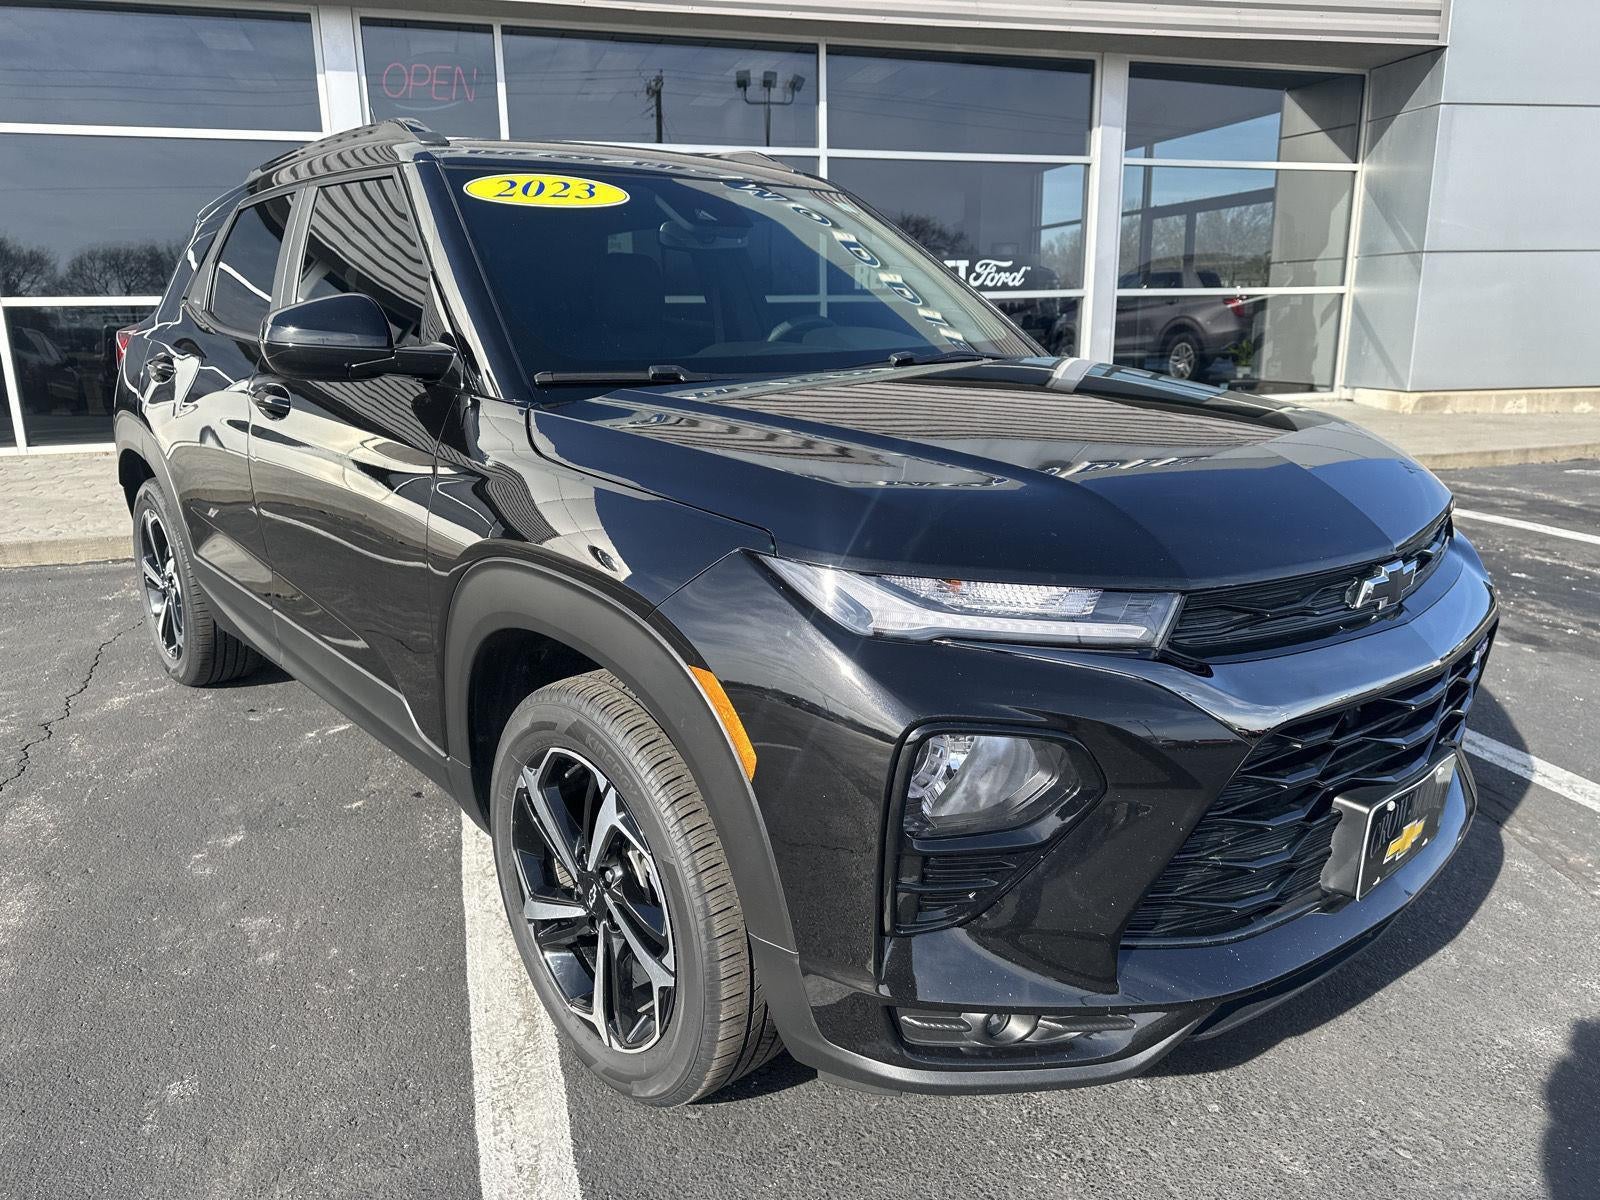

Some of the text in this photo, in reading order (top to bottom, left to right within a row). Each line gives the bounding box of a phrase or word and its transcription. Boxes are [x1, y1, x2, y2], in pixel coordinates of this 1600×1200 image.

[383, 62, 478, 102] OPEN
[494, 179, 596, 200] 2023
[968, 258, 1027, 288] Ford
